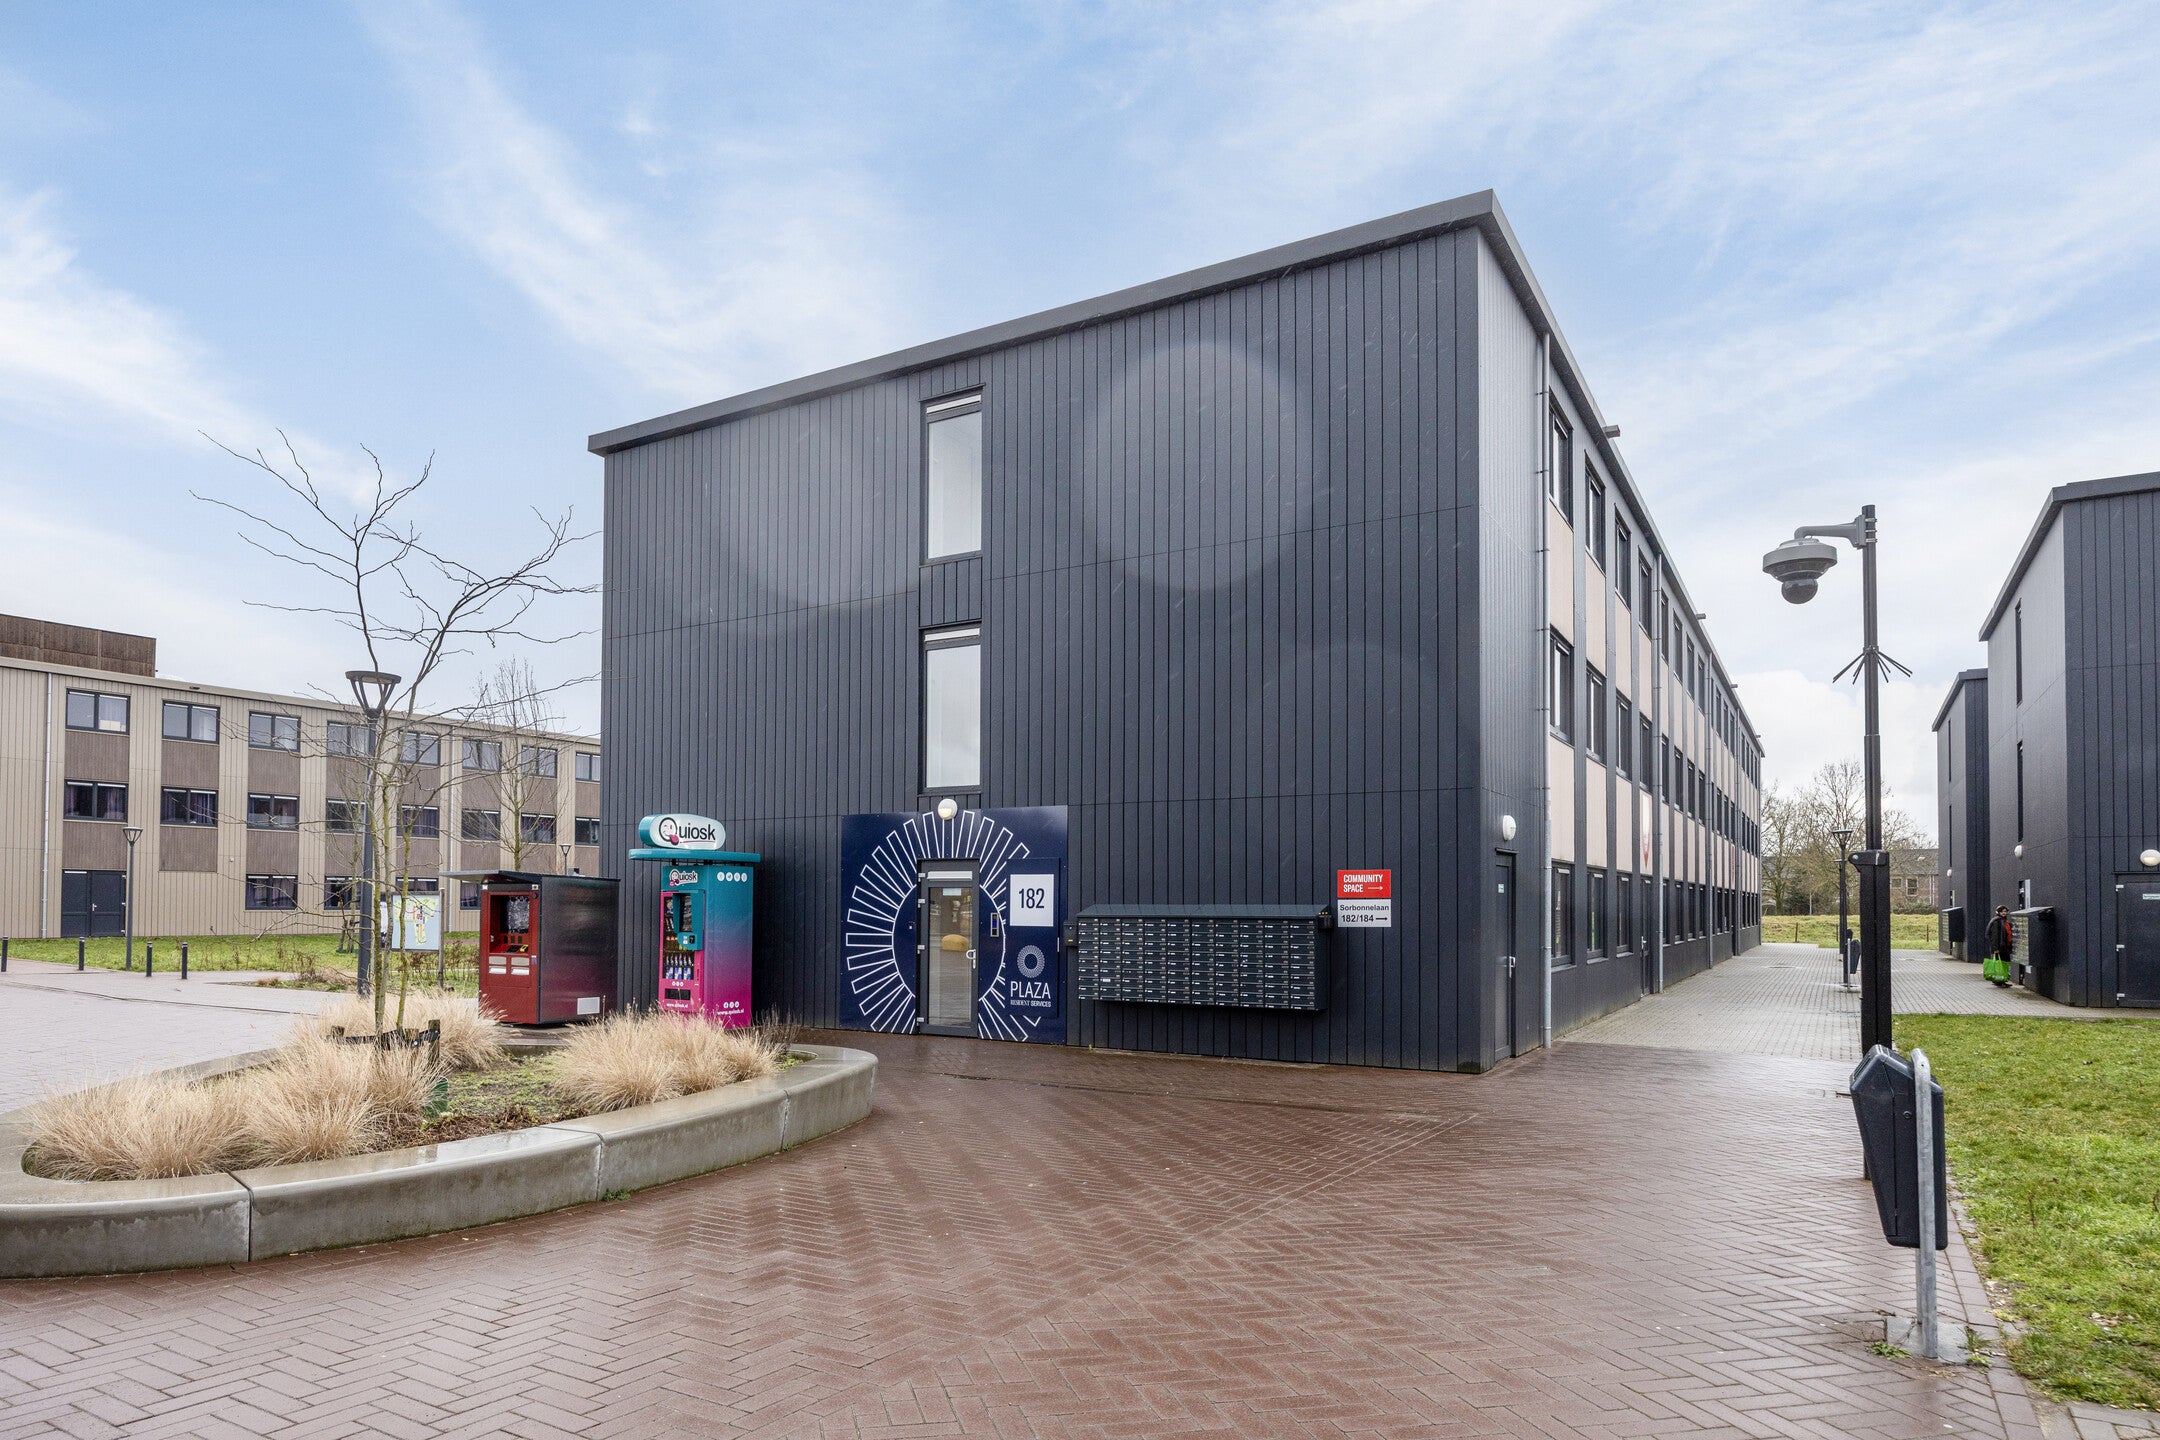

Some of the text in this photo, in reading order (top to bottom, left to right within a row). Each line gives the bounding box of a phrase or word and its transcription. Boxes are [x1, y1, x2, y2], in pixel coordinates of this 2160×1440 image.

[659, 817, 716, 845] Quiosk
[671, 871, 697, 884] Quiosk
[1343, 874, 1383, 883] COMMUNITY
[1343, 884, 1363, 893] SPACE
[1018, 888, 1045, 909] 182
[1341, 914, 1374, 923] 182/184
[1010, 981, 1051, 999] PLAZA
